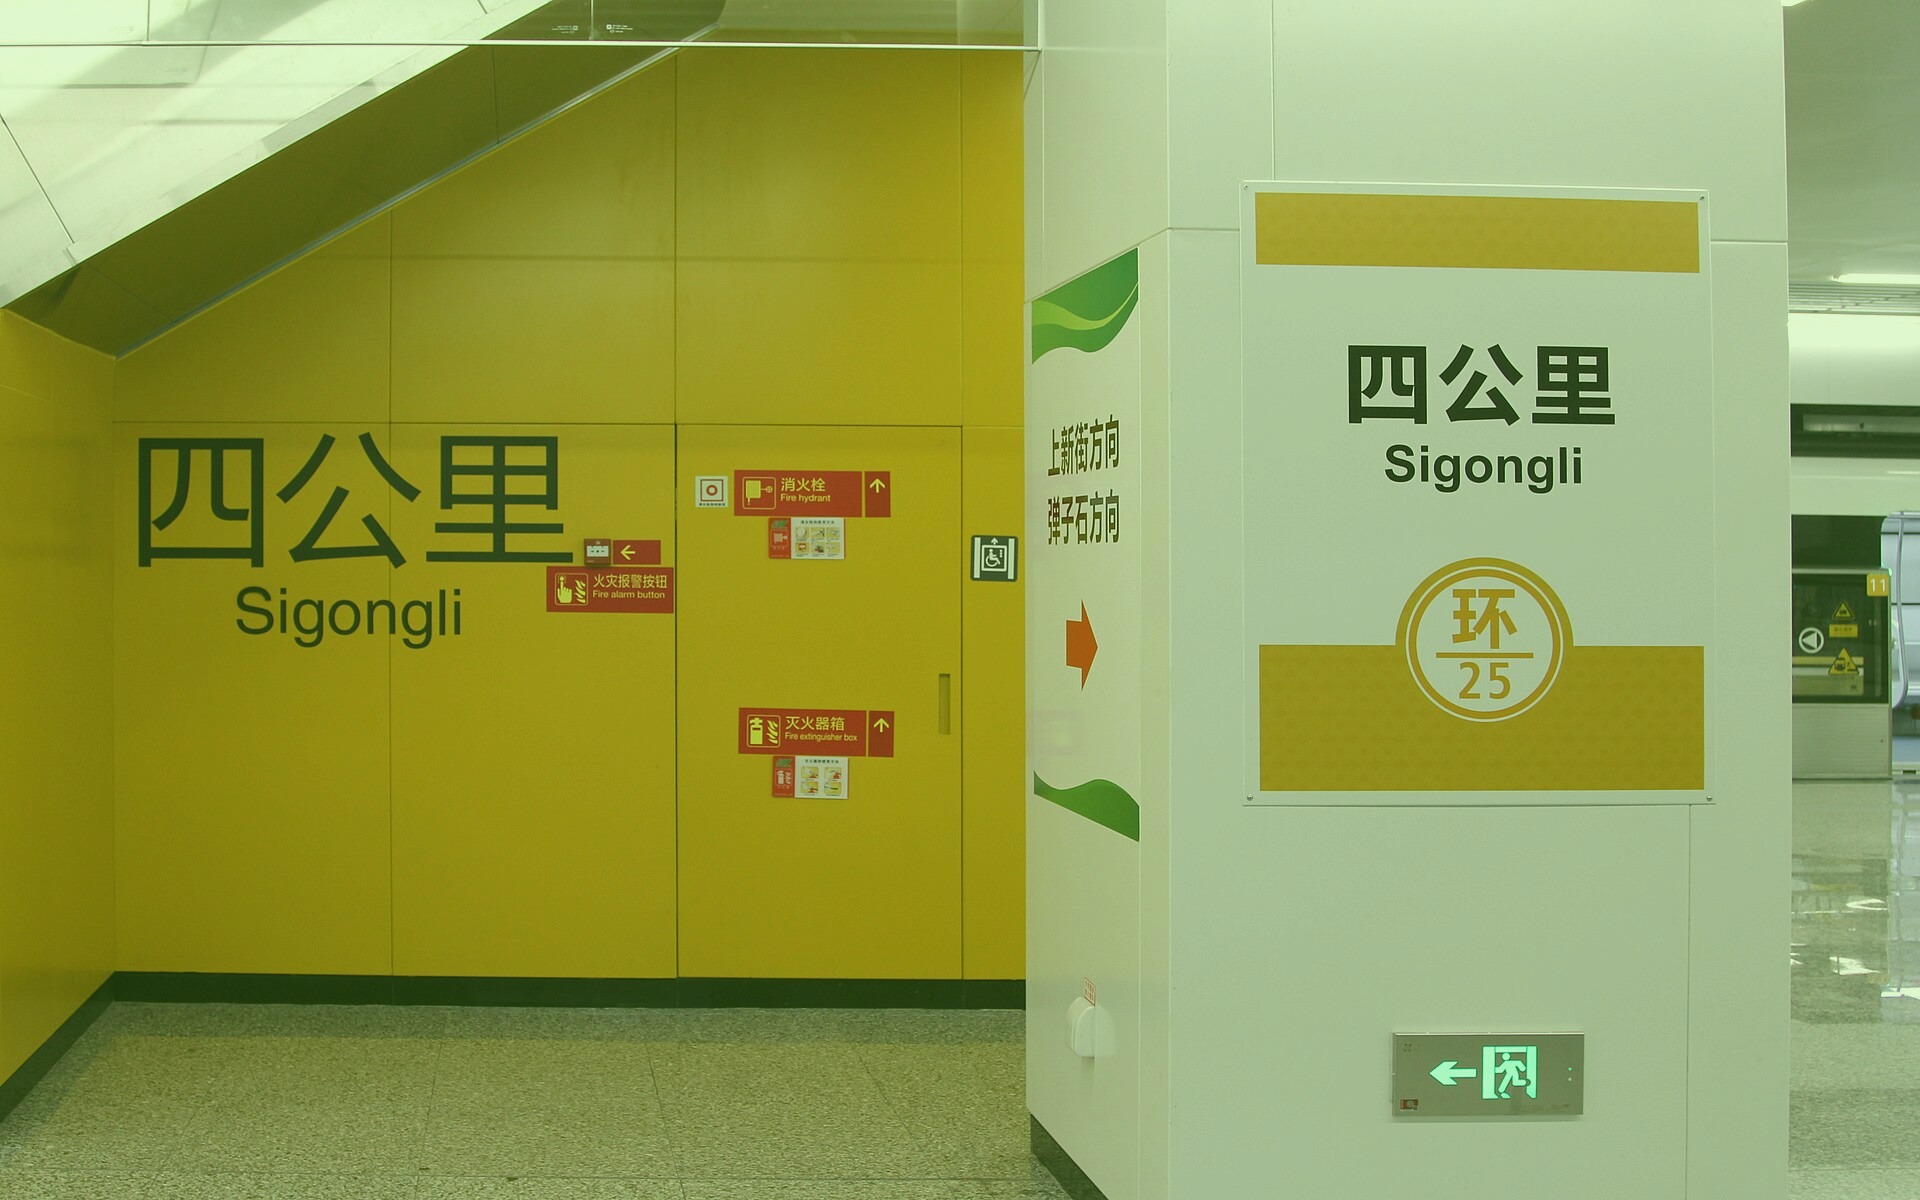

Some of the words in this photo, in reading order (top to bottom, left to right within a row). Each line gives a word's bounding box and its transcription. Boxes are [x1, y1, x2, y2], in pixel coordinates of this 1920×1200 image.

[1347, 343, 1616, 427] 四公里
[1047, 413, 1120, 477] 上新街方向
[780, 476, 826, 493] 消火栓
[1384, 443, 1583, 494] Sigongli
[138, 431, 574, 570] 四公里
[780, 493, 797, 502] Fire
[799, 494, 831, 503] hydrant
[1047, 488, 1120, 546] 弹子石方向
[592, 573, 668, 589] 火灾报警按钮
[592, 590, 609, 598] Fire
[610, 590, 635, 599] alarm
[637, 591, 666, 599] button
[1870, 578, 1886, 593] 11
[235, 585, 461, 650] Sigongli
[1451, 588, 1518, 650] 环
[1457, 661, 1512, 700] 25
[785, 716, 845, 731] 灭火器箱
[785, 732, 798, 740] Fire
[800, 733, 842, 742] extinguisher
